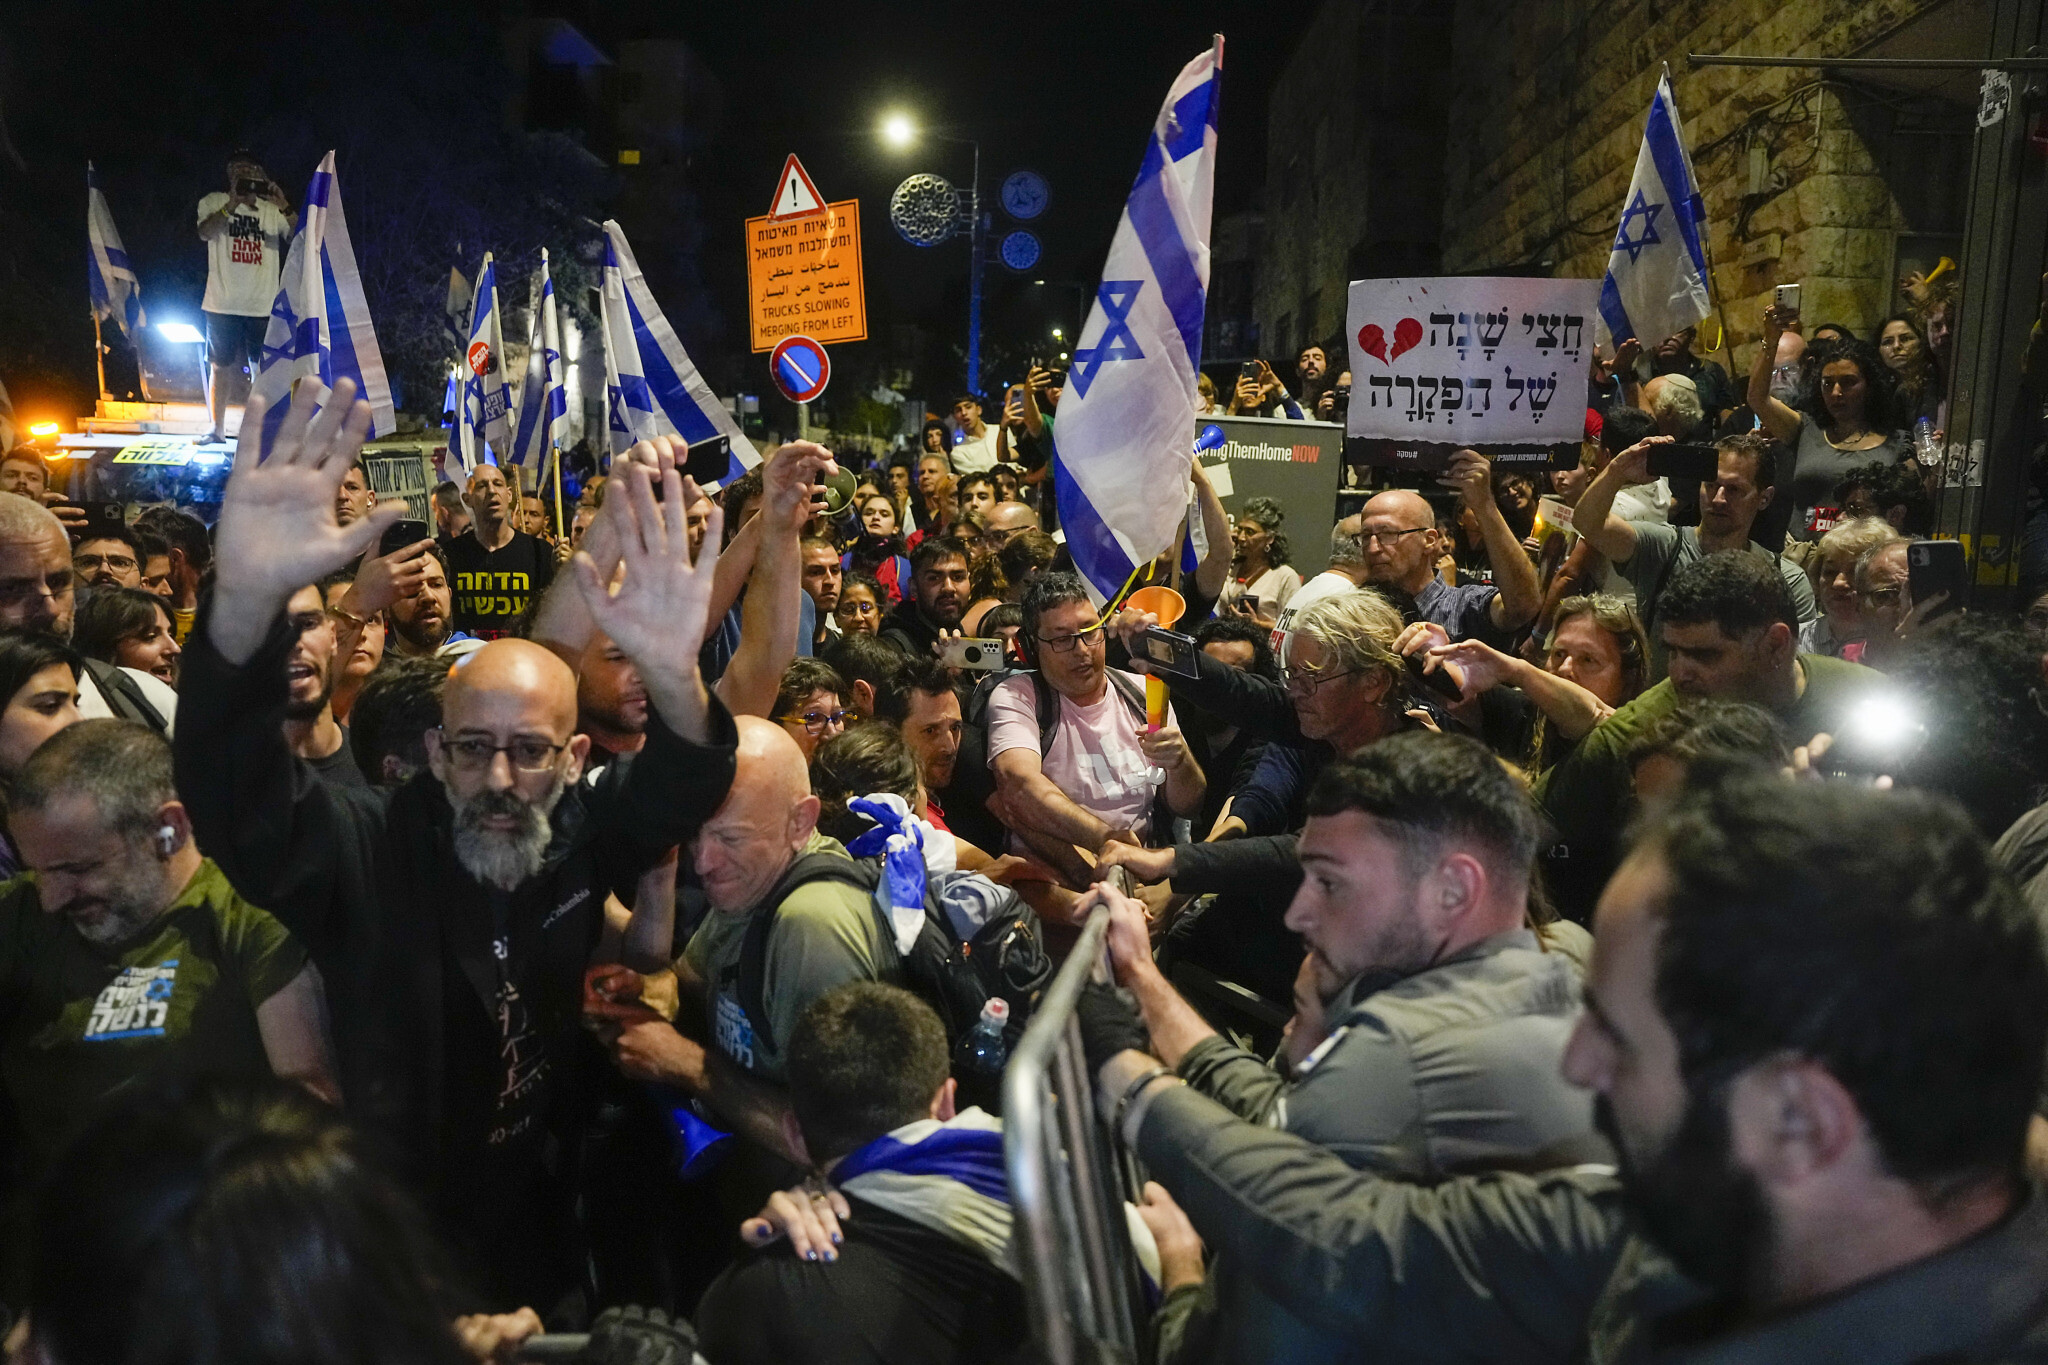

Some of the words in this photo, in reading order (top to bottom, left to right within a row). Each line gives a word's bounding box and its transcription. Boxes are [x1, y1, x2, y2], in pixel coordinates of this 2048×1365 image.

[758, 224, 797, 242] מאיטות
[804, 216, 846, 234] משאיות
[233, 238, 262, 252] אתה
[799, 234, 851, 254] ומשתלבות
[232, 251, 262, 265] אשם
[755, 246, 792, 261] משמאל
[760, 285, 788, 303] اليسار
[796, 285, 811, 297] من
[763, 303, 800, 319] TRUCKS
[805, 297, 850, 314] SLOWING
[760, 322, 800, 338] MERGING
[803, 318, 829, 333] FROM
[832, 315, 854, 330] LEFT
[1396, 450, 1418, 459] #עסקה
[457, 571, 530, 591] הדחה
[458, 596, 529, 616] עכשיו
